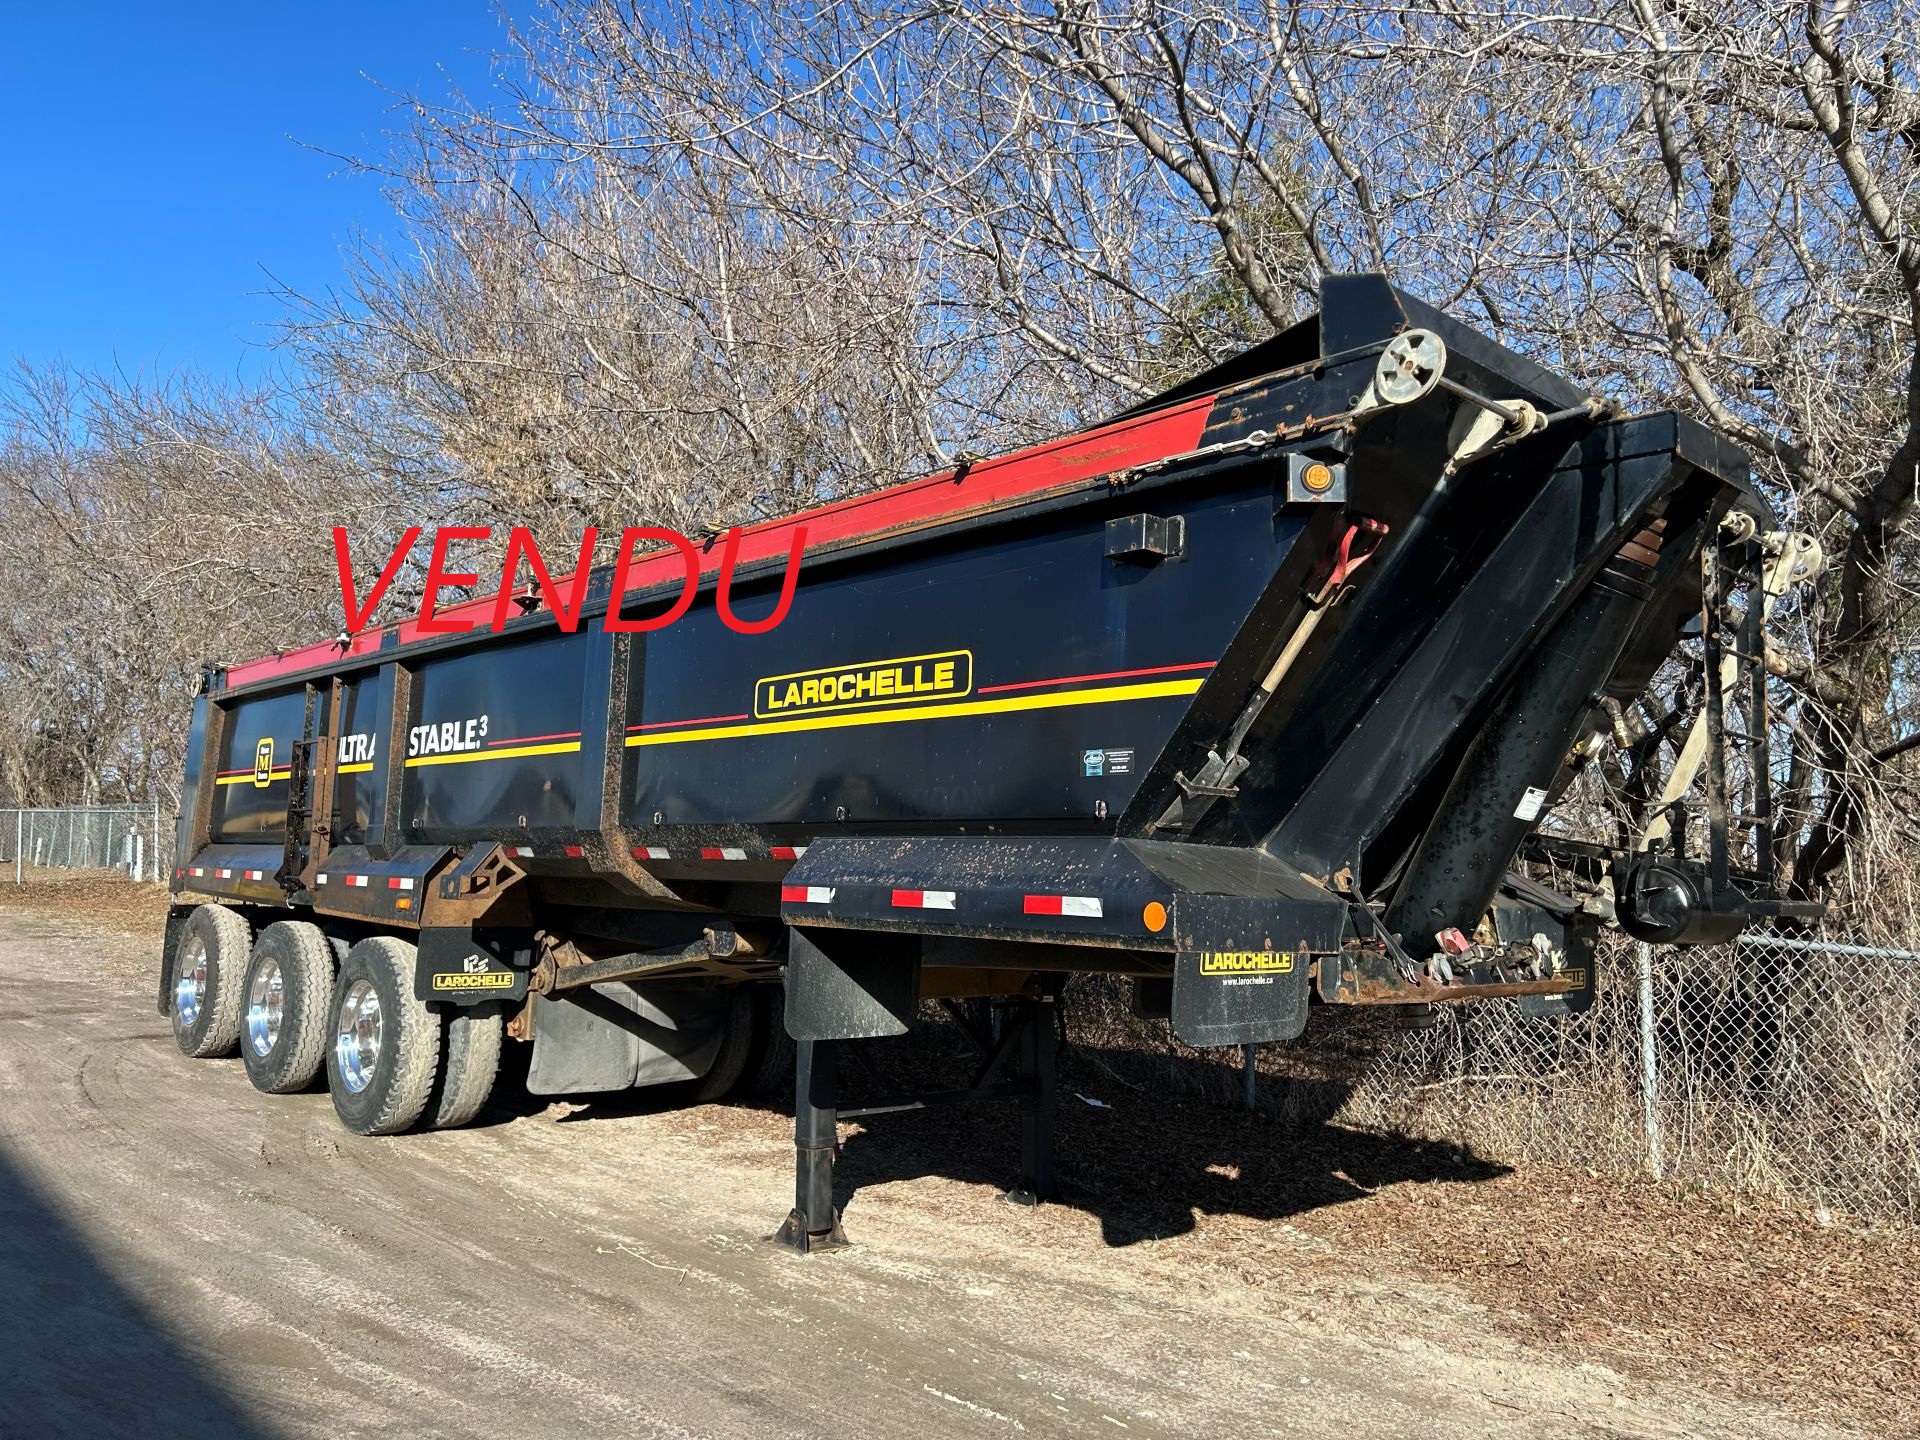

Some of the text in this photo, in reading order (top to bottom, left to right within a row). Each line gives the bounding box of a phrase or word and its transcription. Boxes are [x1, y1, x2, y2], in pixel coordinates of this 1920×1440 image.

[767, 661, 955, 710] LAROCHELLE
[1204, 951, 1290, 971] LAROCHELLE
[436, 974, 512, 988] LAROCHELLE
[1222, 976, 1274, 986] www.larochelle.ca
